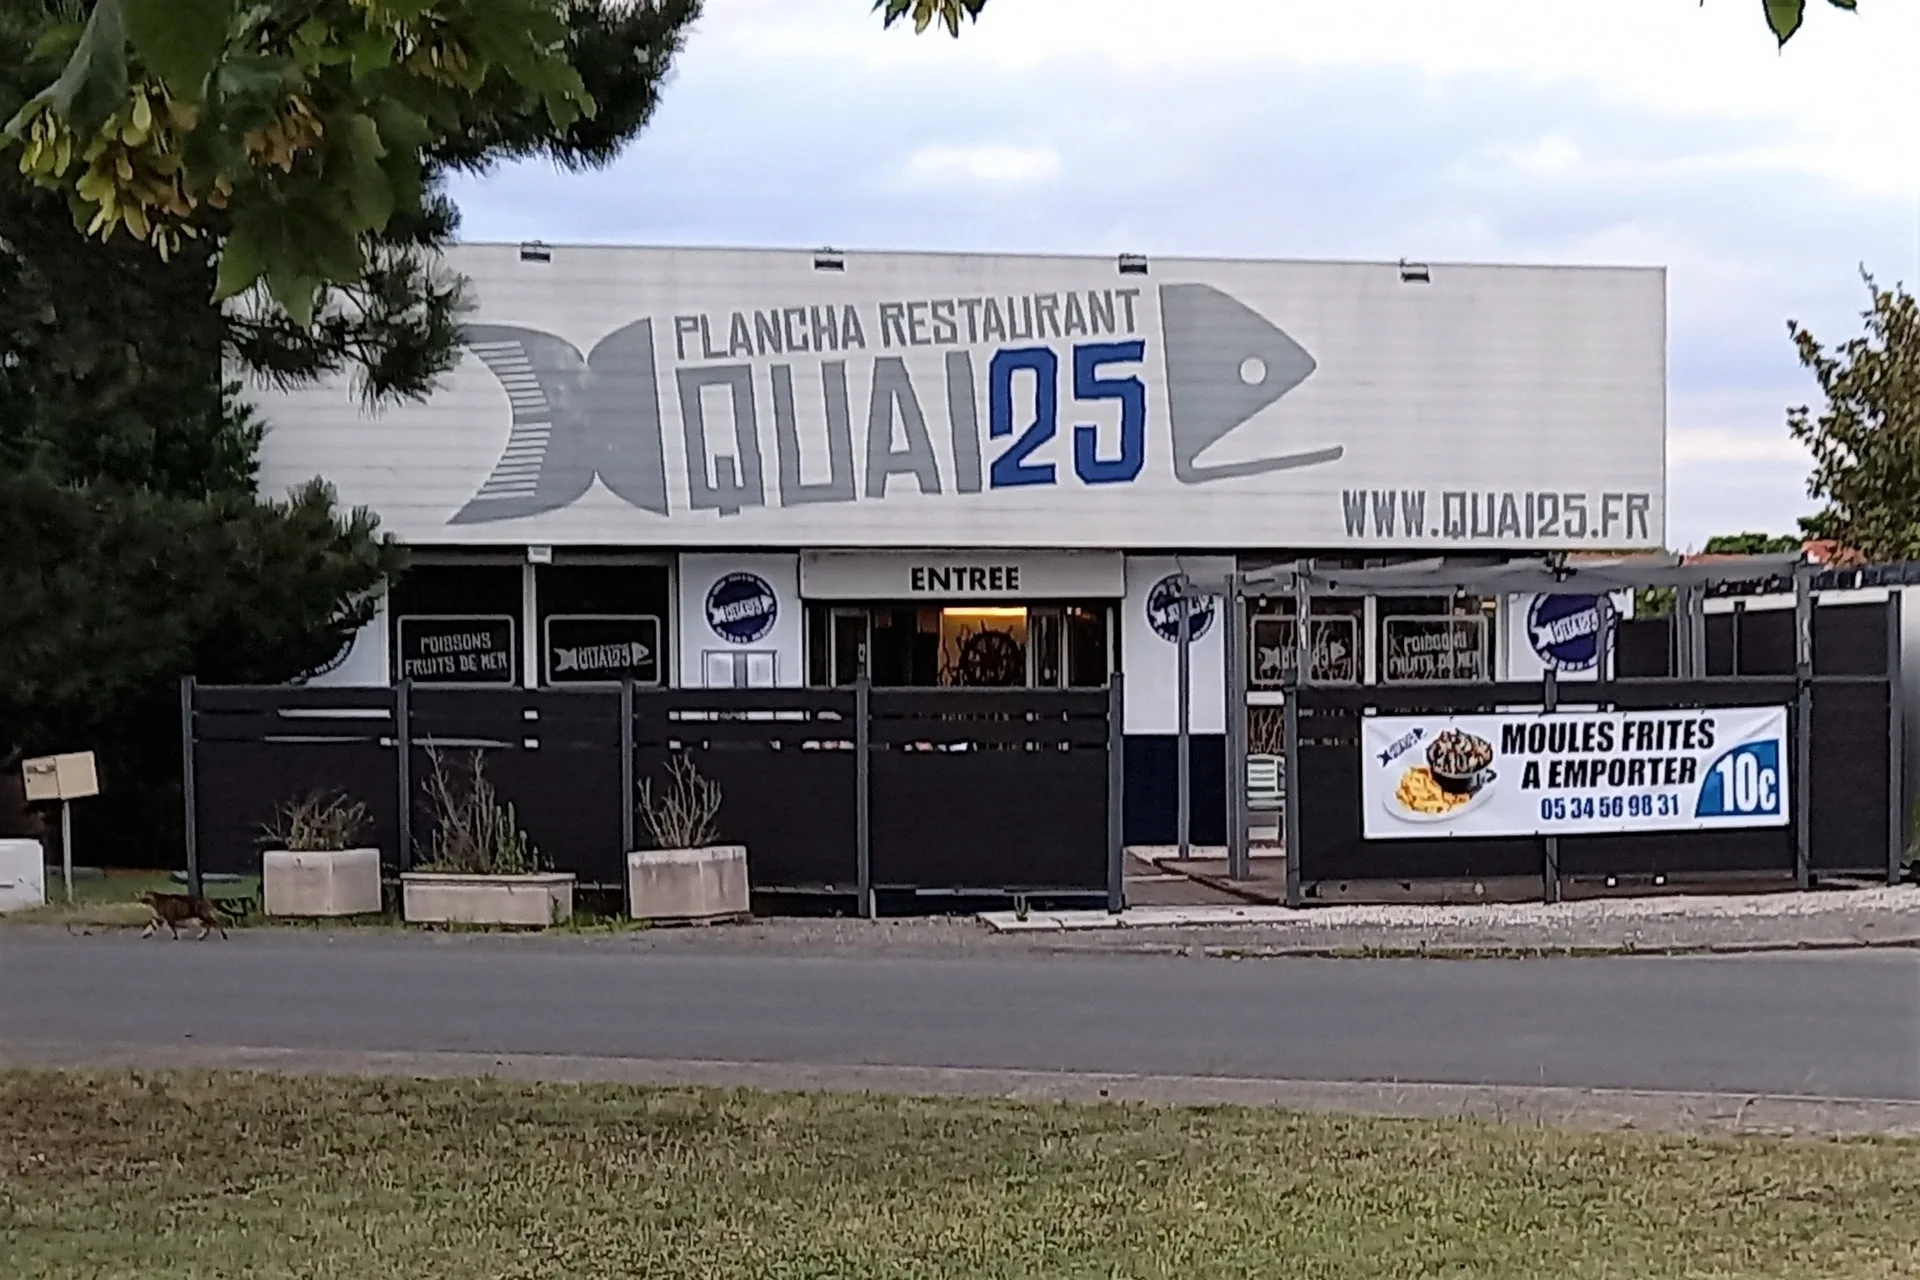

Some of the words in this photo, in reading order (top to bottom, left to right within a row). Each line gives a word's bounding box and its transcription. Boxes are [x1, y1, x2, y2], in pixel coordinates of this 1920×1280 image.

[674, 304, 866, 360] PLANCHA
[878, 288, 1141, 348] RESTAURANT
[1342, 489, 1650, 539] WWW.QUAI25.FR
[910, 566, 1020, 592] ENTREE
[405, 655, 455, 676] FRUITS
[459, 653, 478, 672] DE
[1501, 722, 1615, 755] MOULES
[1621, 718, 1716, 752] FRITES
[1521, 762, 1541, 790] A
[1547, 756, 1698, 787] EMPORTER
[1540, 797, 1566, 821] 05
[1570, 797, 1594, 819] 34
[1656, 793, 1679, 816] 31
